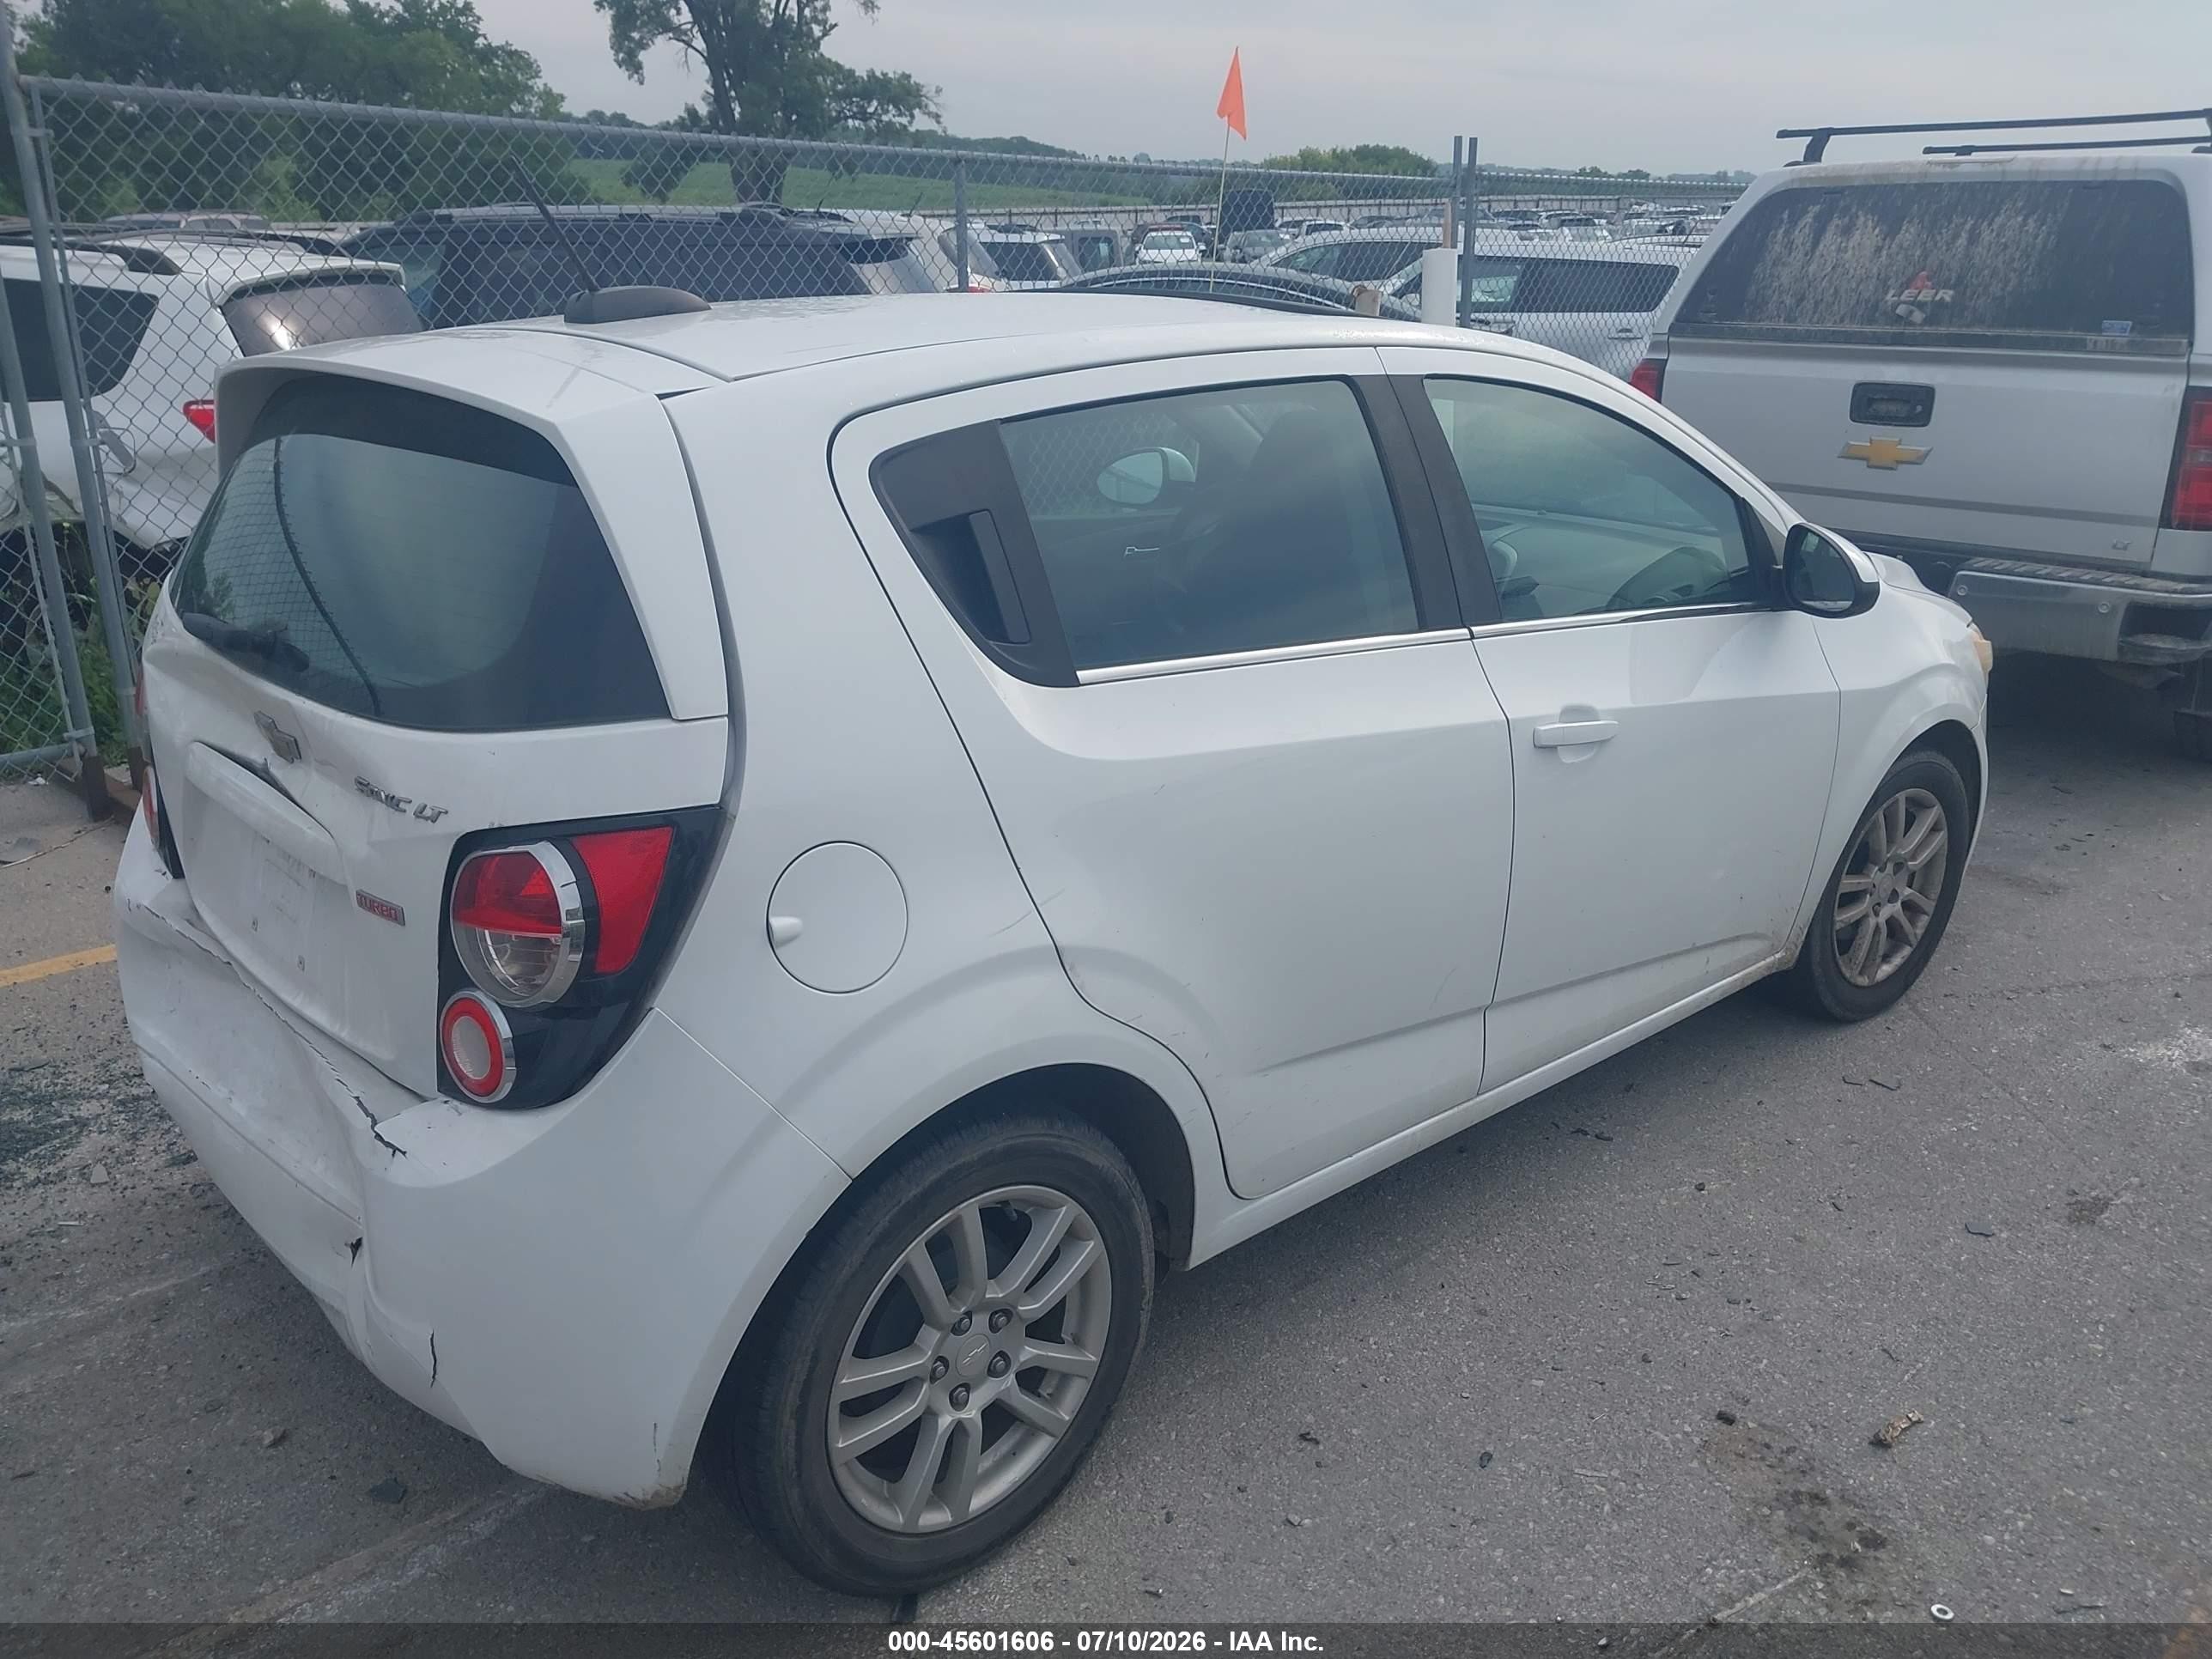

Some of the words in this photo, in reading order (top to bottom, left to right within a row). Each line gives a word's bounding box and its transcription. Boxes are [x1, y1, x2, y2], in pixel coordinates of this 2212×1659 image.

[1885, 289, 1954, 302] LEER
[2112, 539, 2132, 551] LT
[412, 802, 448, 824] LT
[356, 892, 399, 922] TURBO
